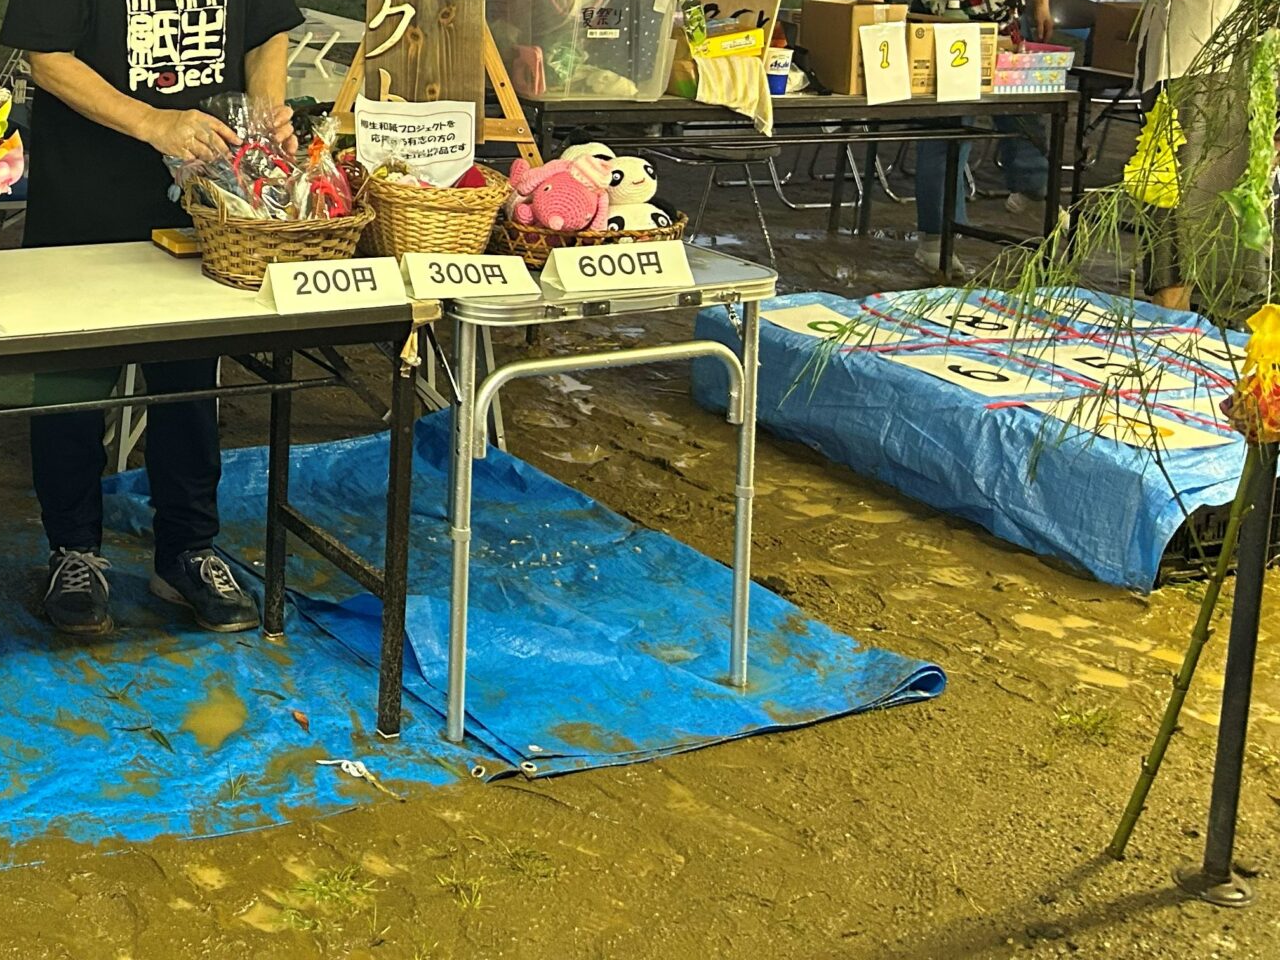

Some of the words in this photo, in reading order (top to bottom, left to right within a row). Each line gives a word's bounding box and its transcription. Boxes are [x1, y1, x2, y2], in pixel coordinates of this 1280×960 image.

[581, 6, 622, 28] 夏祭り
[879, 40, 890, 69] 1
[949, 39, 969, 68] 2
[129, 62, 225, 94] Project
[429, 261, 508, 286] 300円
[578, 250, 663, 279] 600円
[293, 266, 378, 296] 200円
[947, 364, 1010, 382] 6
